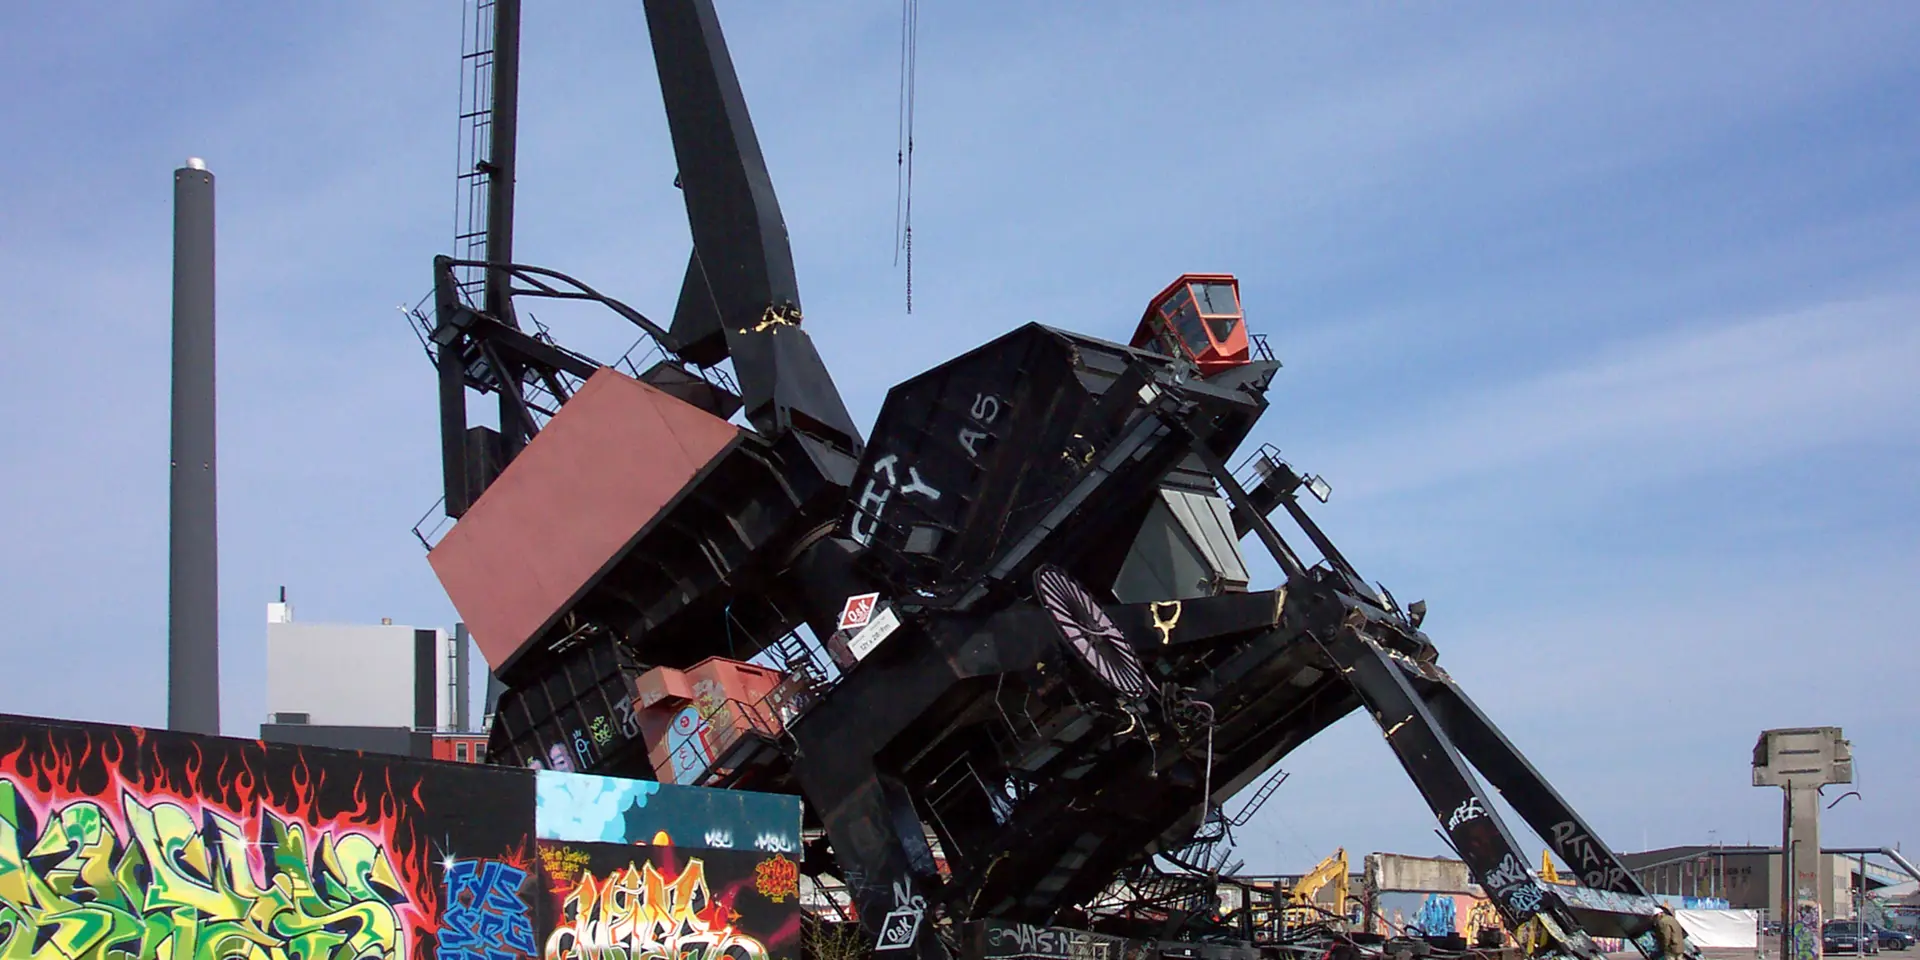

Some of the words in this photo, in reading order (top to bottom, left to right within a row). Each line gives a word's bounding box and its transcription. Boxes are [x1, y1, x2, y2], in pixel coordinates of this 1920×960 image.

[848, 599, 870, 622] O&K
[444, 860, 529, 914] FYS
[886, 916, 912, 943] O&K
